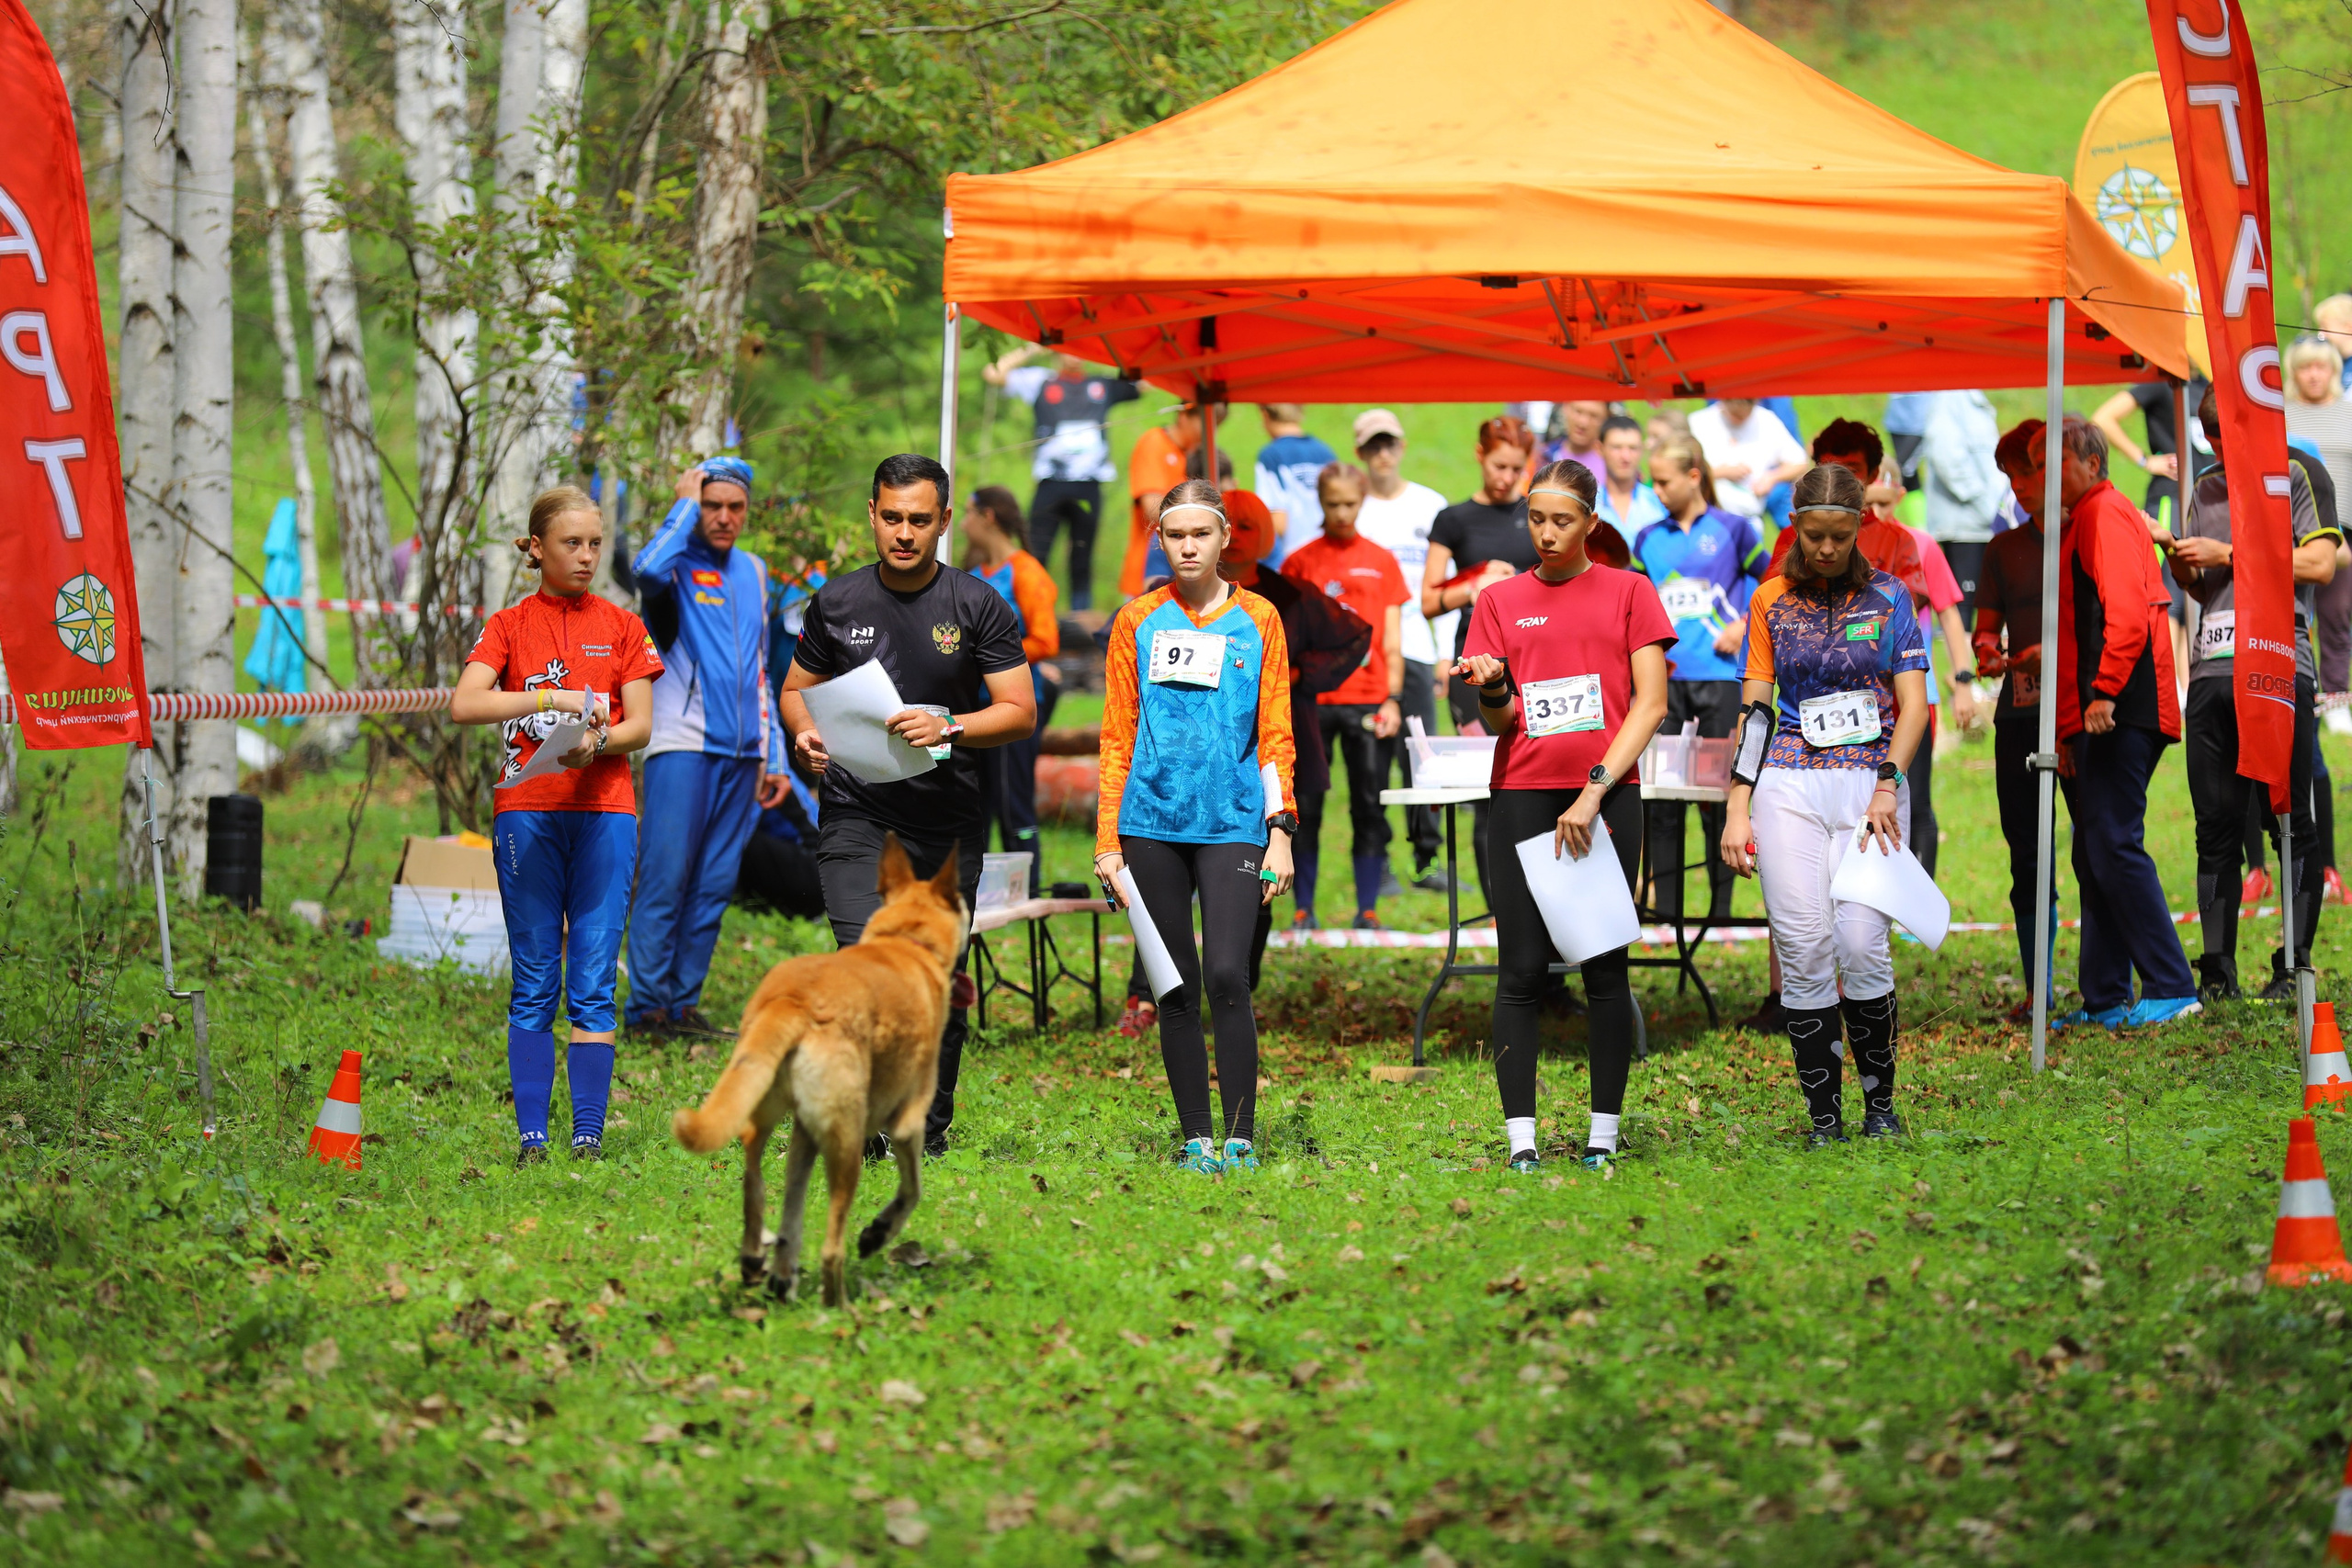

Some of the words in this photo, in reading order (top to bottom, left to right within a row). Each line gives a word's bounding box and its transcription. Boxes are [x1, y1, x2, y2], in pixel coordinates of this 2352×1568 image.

[1515, 616, 1549, 629] RAY
[1852, 625, 1872, 635] SFR
[2207, 627, 2234, 644] 387
[1168, 647, 1194, 666] 97
[1535, 694, 1584, 719] 337
[1813, 707, 1860, 731] 131
